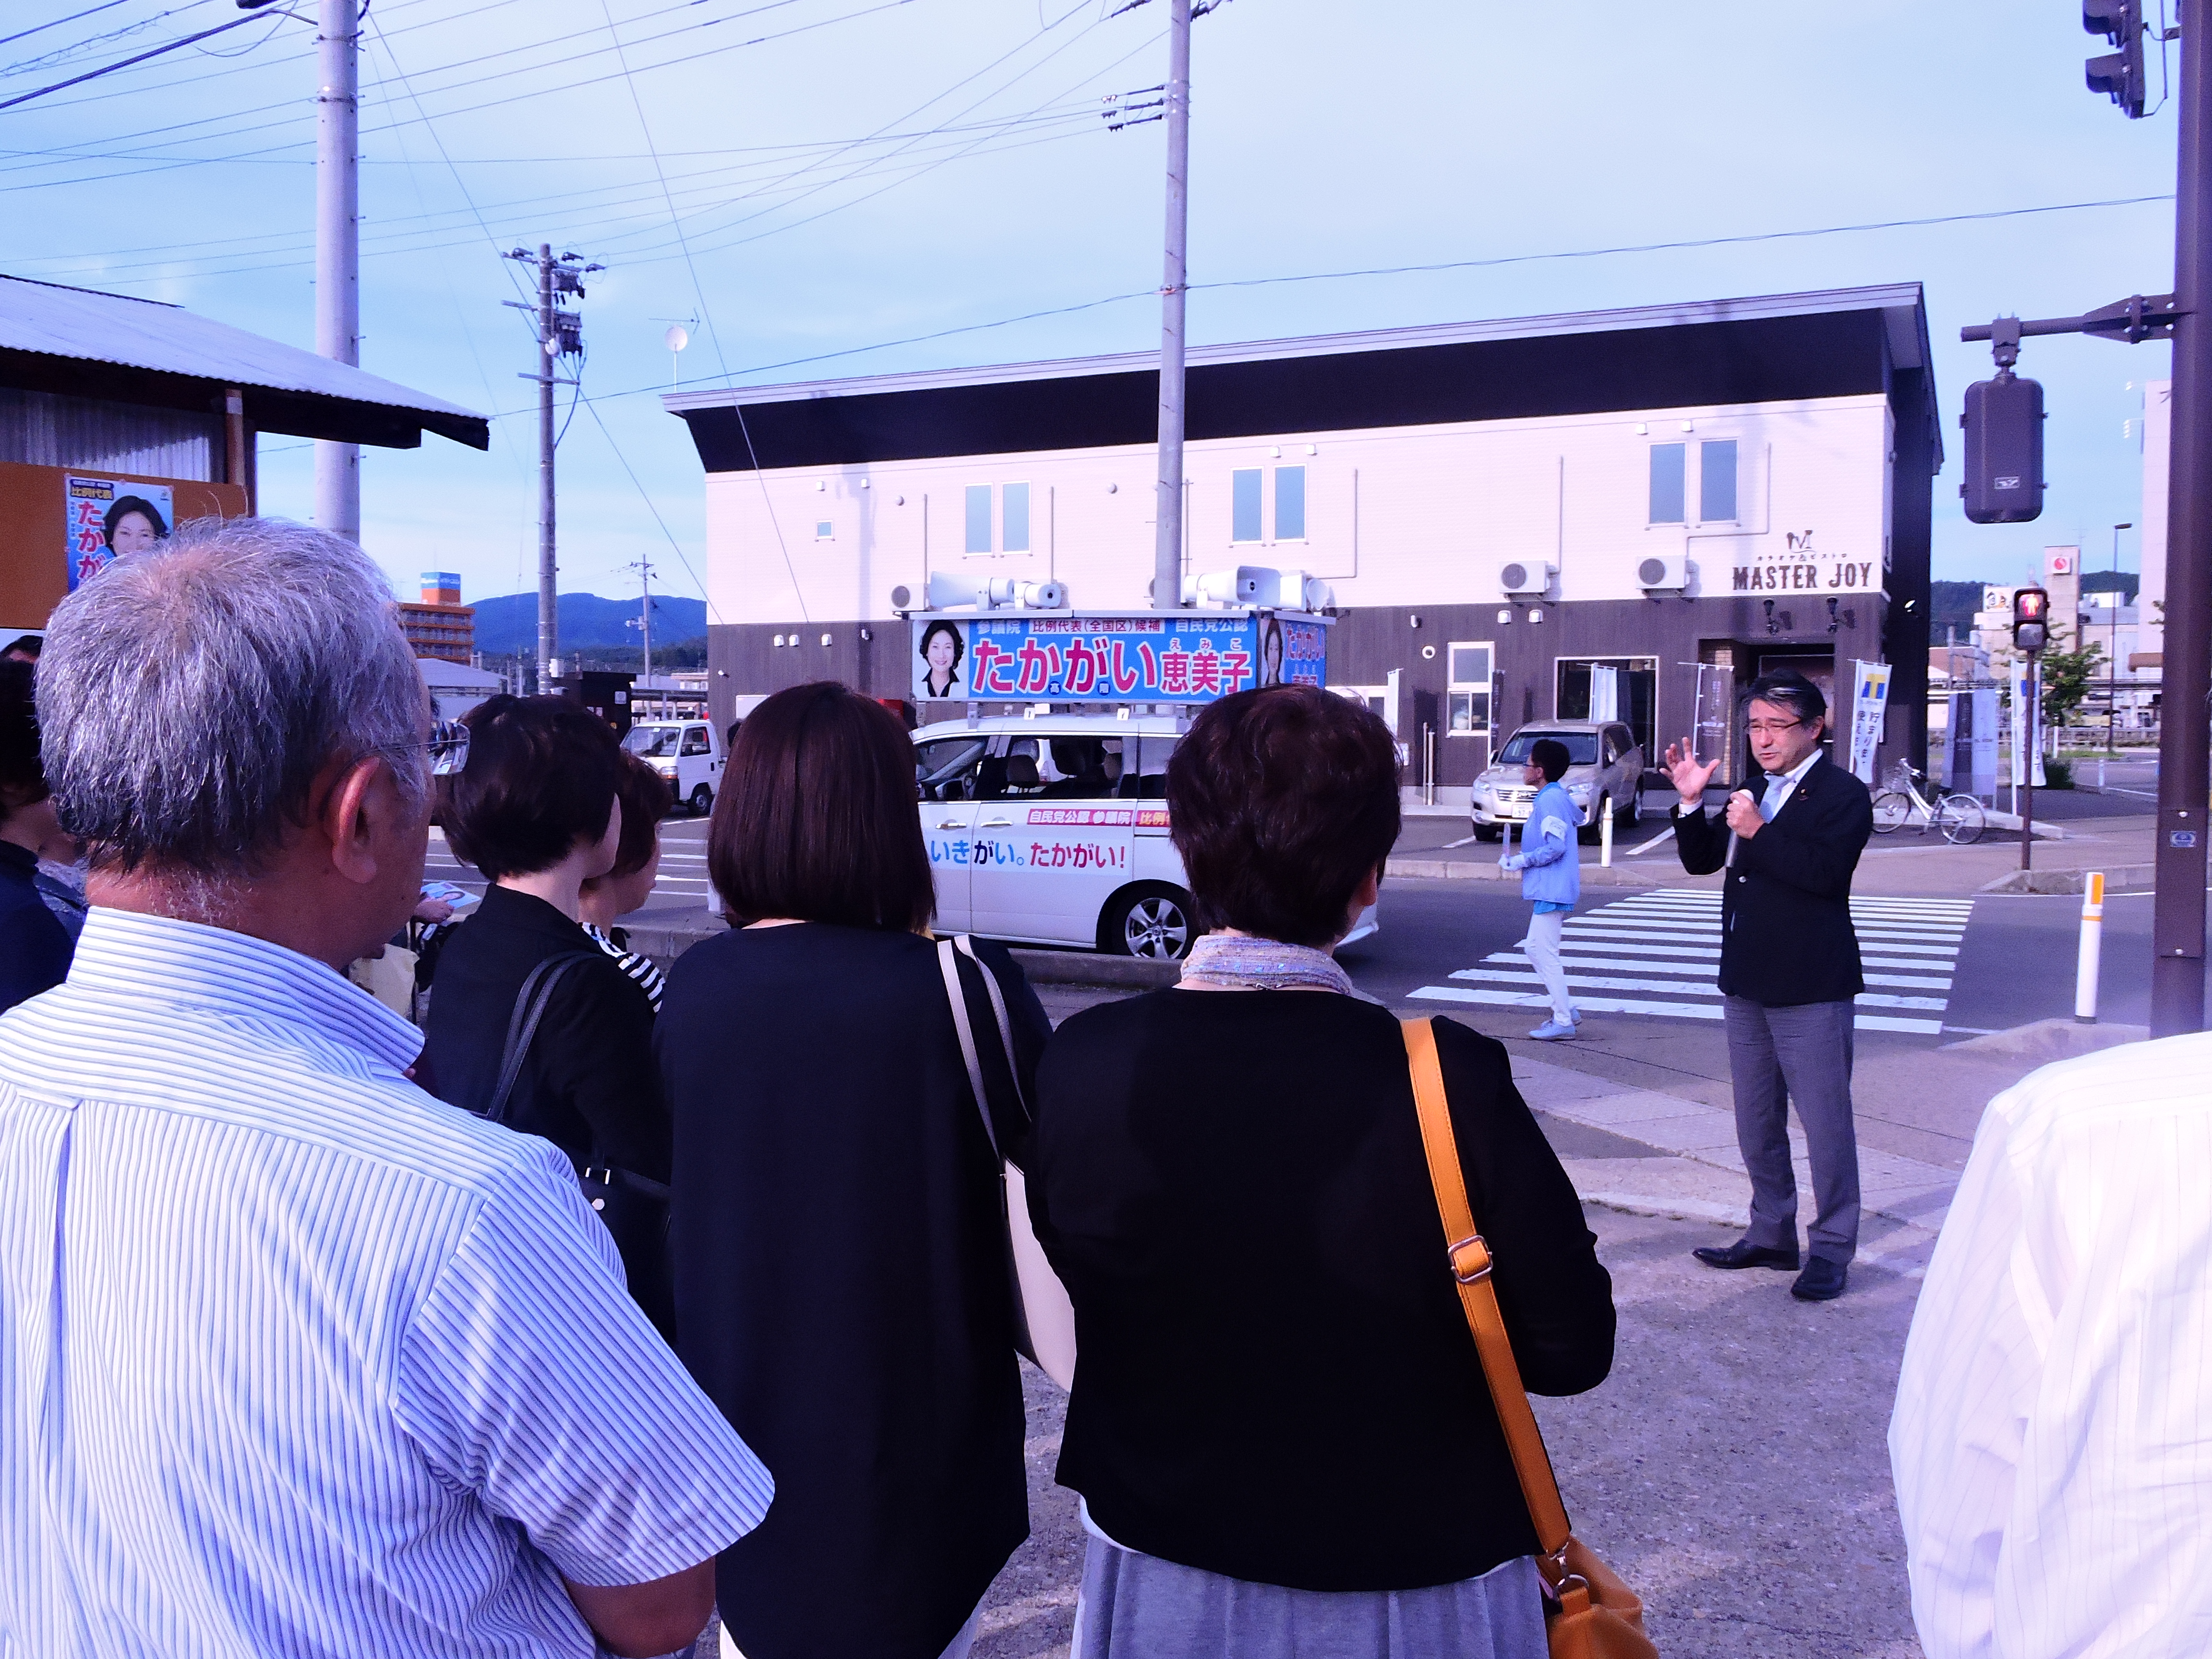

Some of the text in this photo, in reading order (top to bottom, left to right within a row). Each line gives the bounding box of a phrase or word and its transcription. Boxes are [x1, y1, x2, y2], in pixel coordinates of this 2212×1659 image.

[1732, 562, 1872, 590] MASTER JOY
[931, 840, 1125, 868] いきがい。 たかがい！
